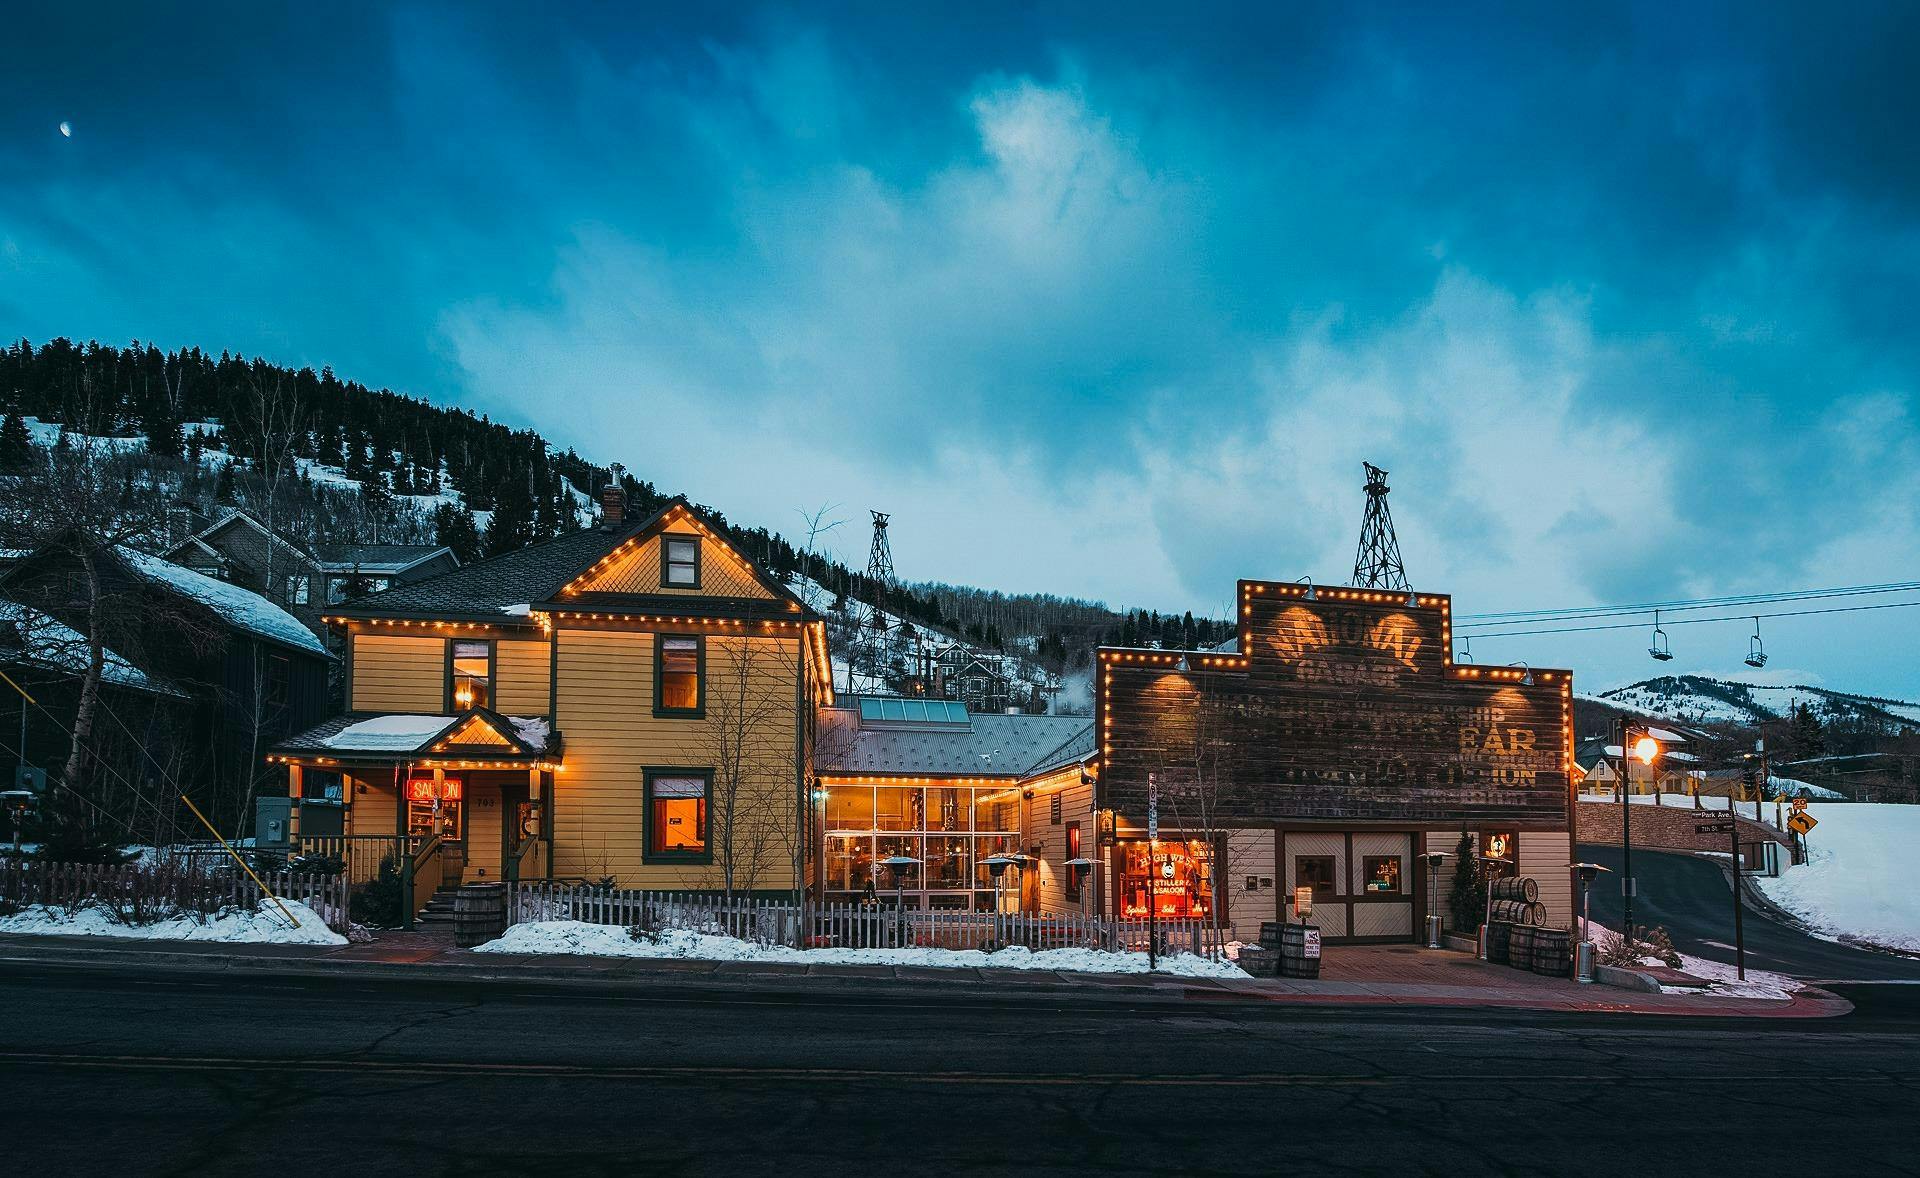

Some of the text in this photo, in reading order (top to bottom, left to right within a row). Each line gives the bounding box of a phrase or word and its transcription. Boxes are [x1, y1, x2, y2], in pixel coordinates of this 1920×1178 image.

[1266, 610, 1422, 673] NATIONAL
[414, 782, 458, 798] SALON
[1140, 853, 1168, 867] HIGH
